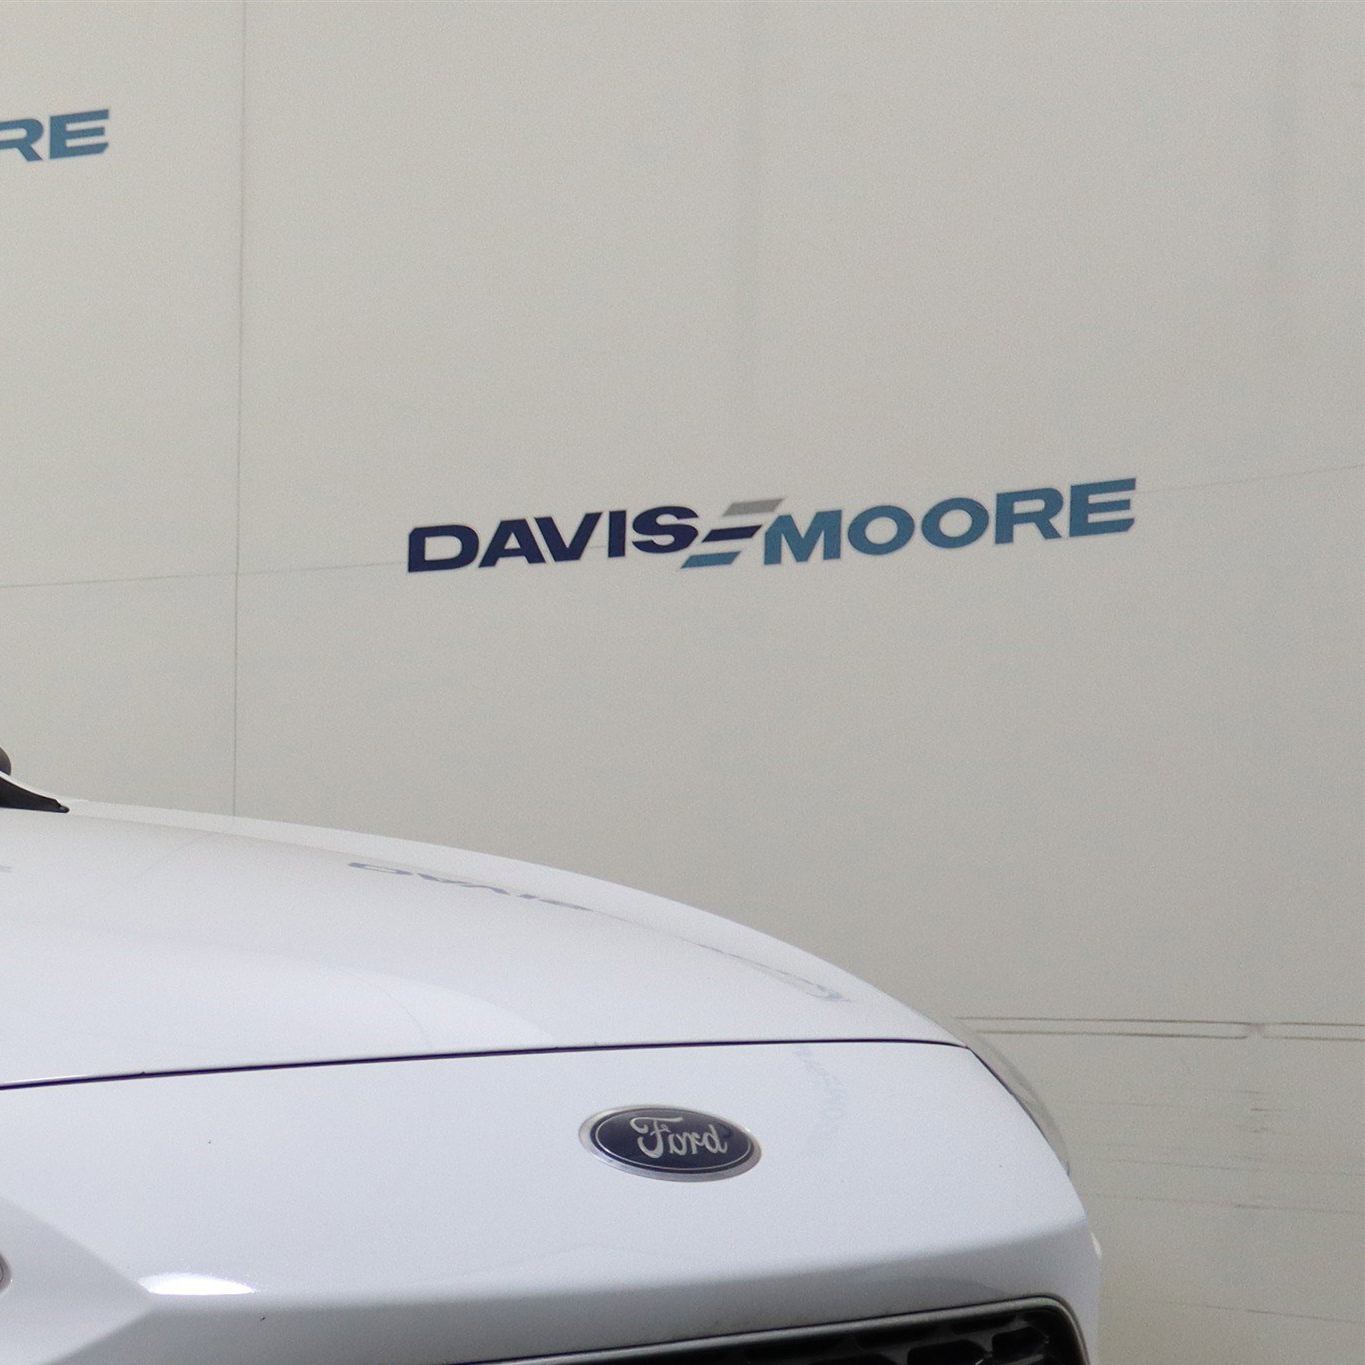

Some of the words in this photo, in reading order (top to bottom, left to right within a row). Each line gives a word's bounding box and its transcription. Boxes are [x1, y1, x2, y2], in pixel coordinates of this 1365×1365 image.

[407, 504, 700, 573] DAVIS
[762, 477, 1137, 566] MOORE
[630, 1116, 729, 1159] Ford
